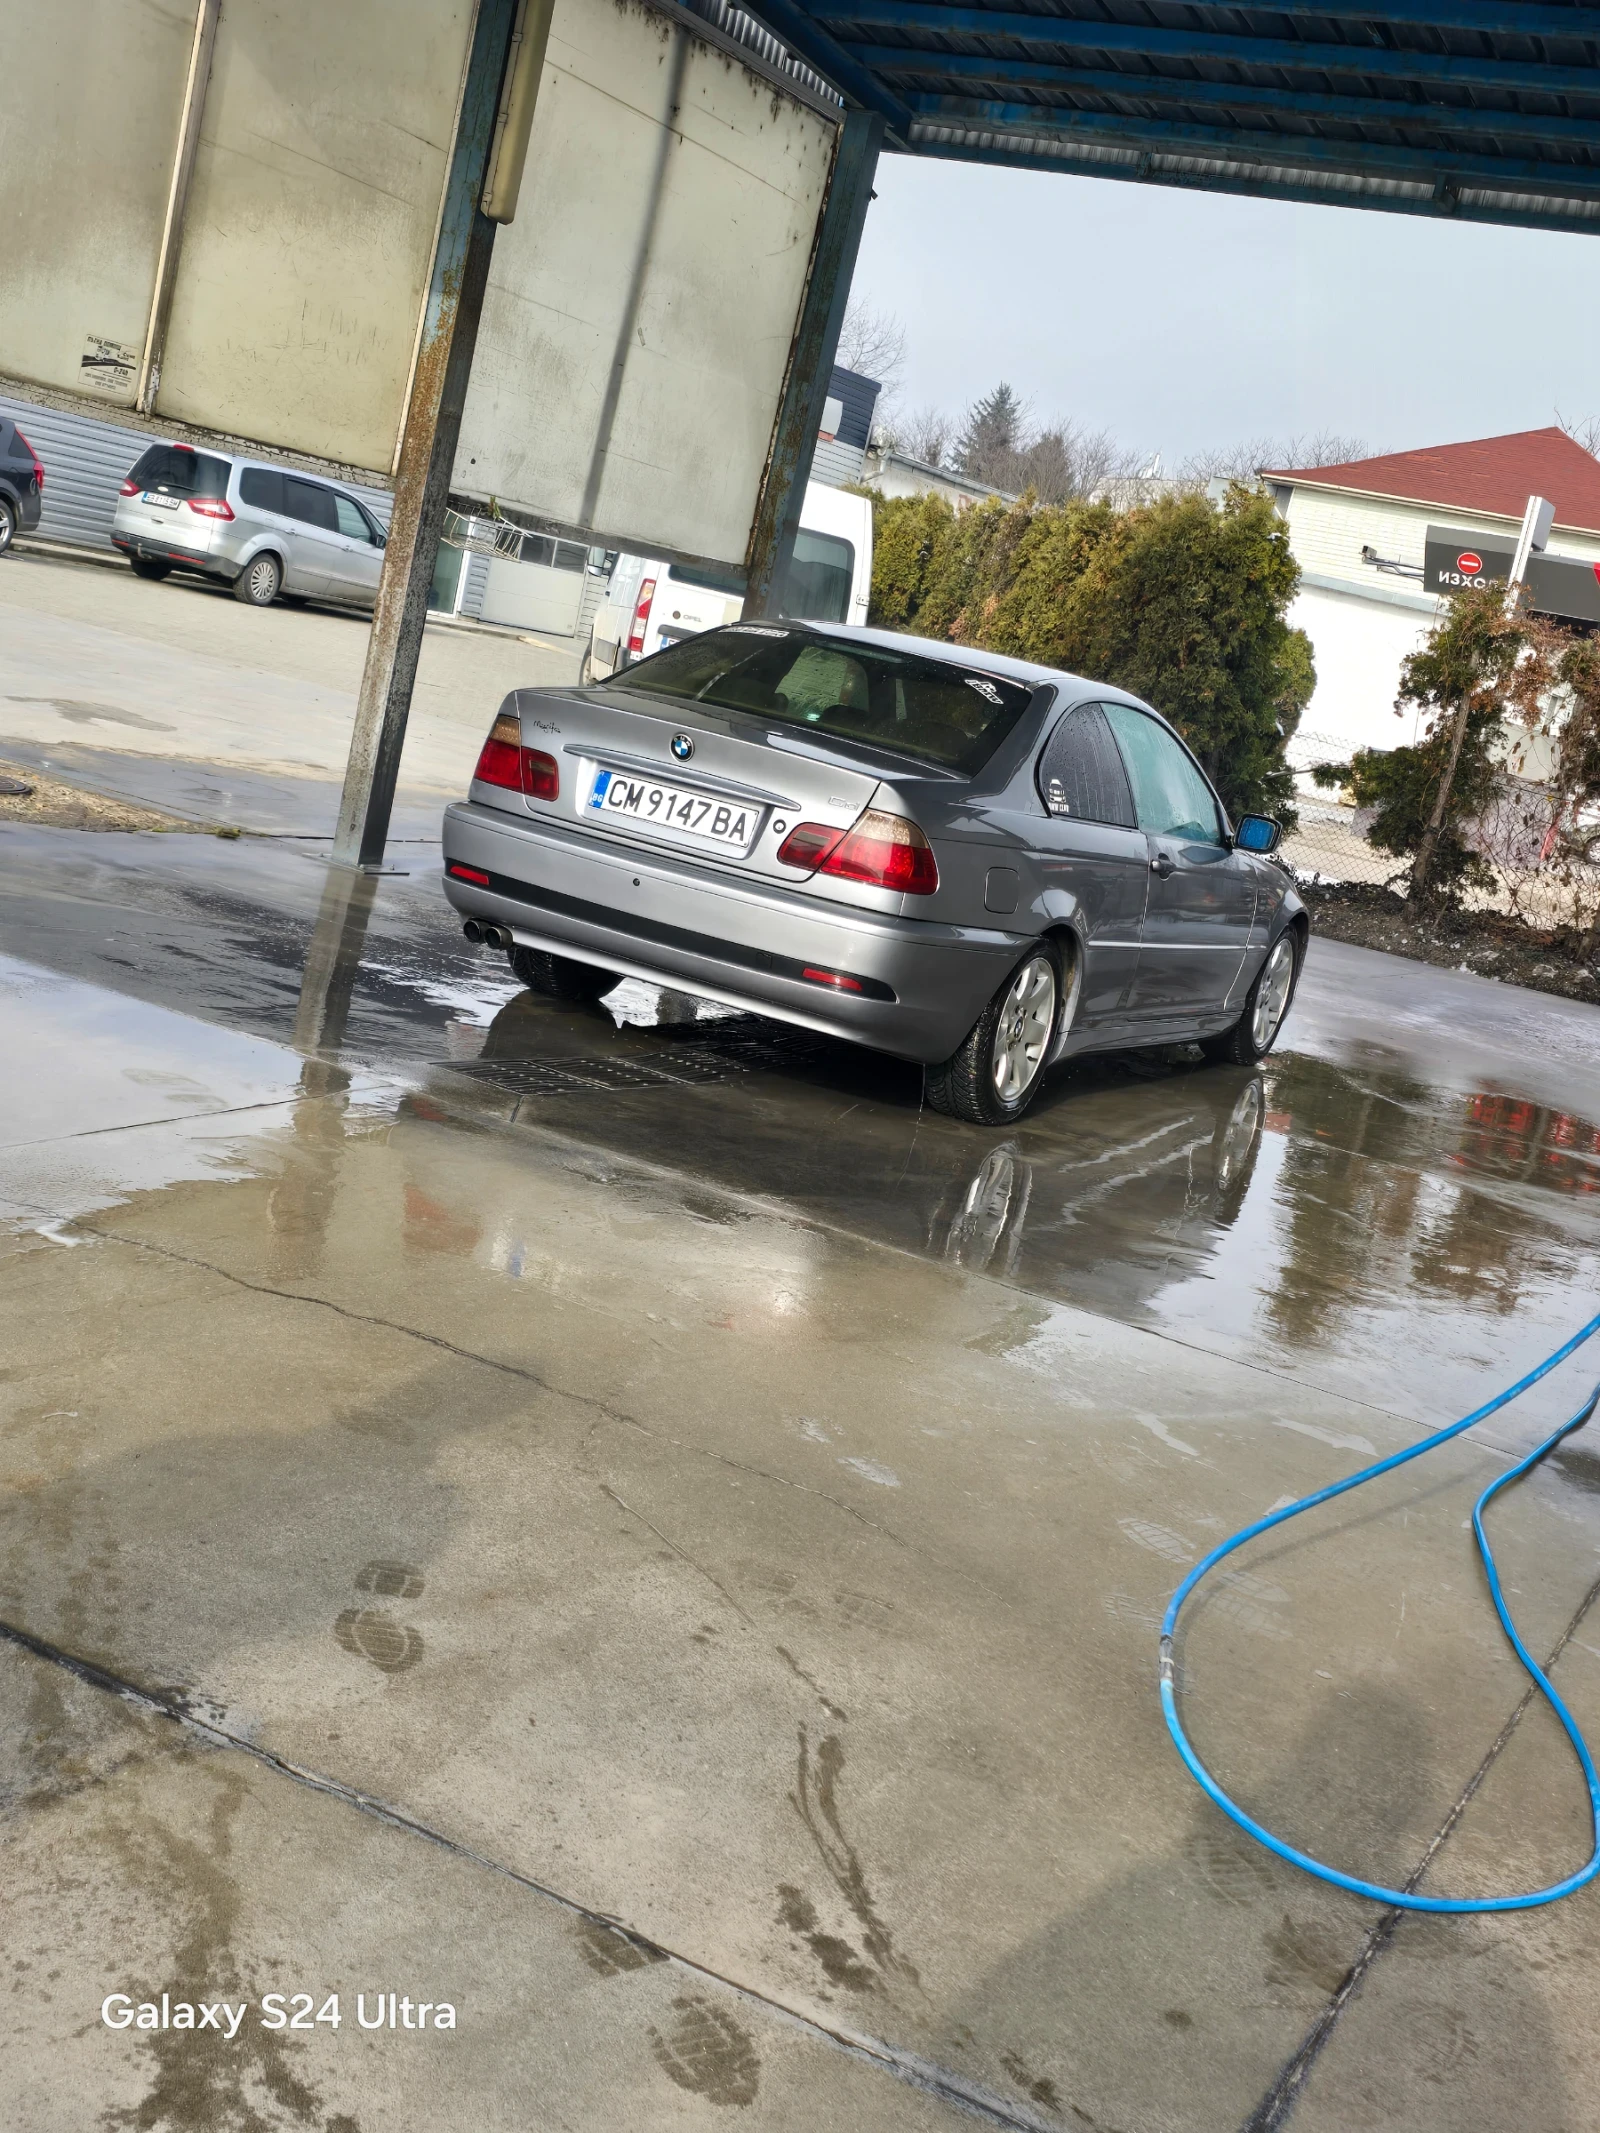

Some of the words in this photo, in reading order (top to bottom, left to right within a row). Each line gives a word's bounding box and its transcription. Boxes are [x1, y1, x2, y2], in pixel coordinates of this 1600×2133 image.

[683, 614, 702, 623] OPEL
[592, 792, 604, 803] BG
[608, 780, 646, 813] CM
[646, 789, 713, 828] 9147
[710, 806, 747, 842] BA
